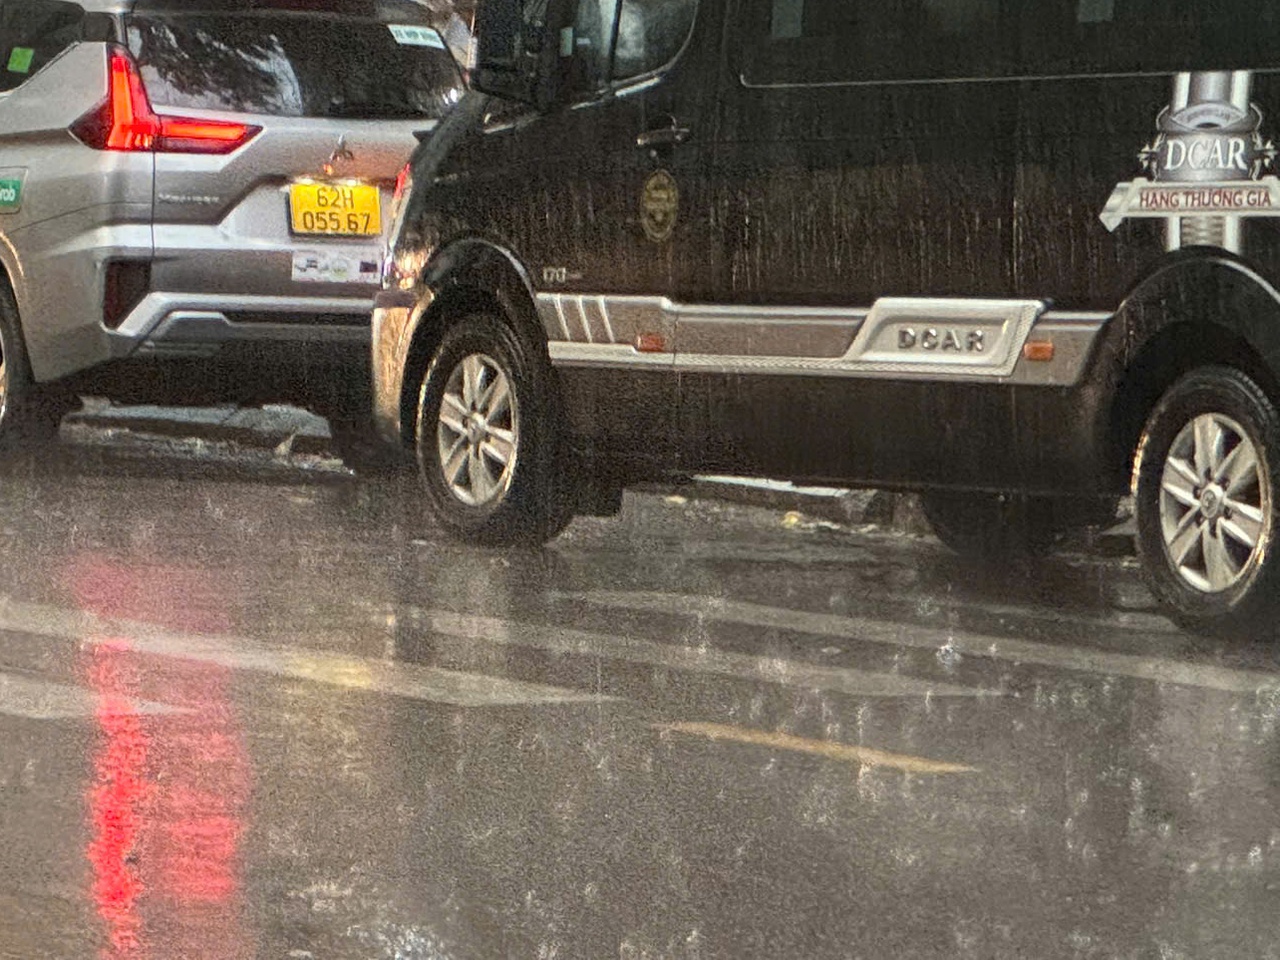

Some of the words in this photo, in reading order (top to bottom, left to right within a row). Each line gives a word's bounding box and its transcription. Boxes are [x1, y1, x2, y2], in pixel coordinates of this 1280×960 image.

[1164, 138, 1248, 171] DCAR
[317, 188, 354, 209] 62H
[1247, 190, 1272, 208] GIA
[303, 211, 371, 233] 055.67
[898, 328, 985, 352] DCAR
